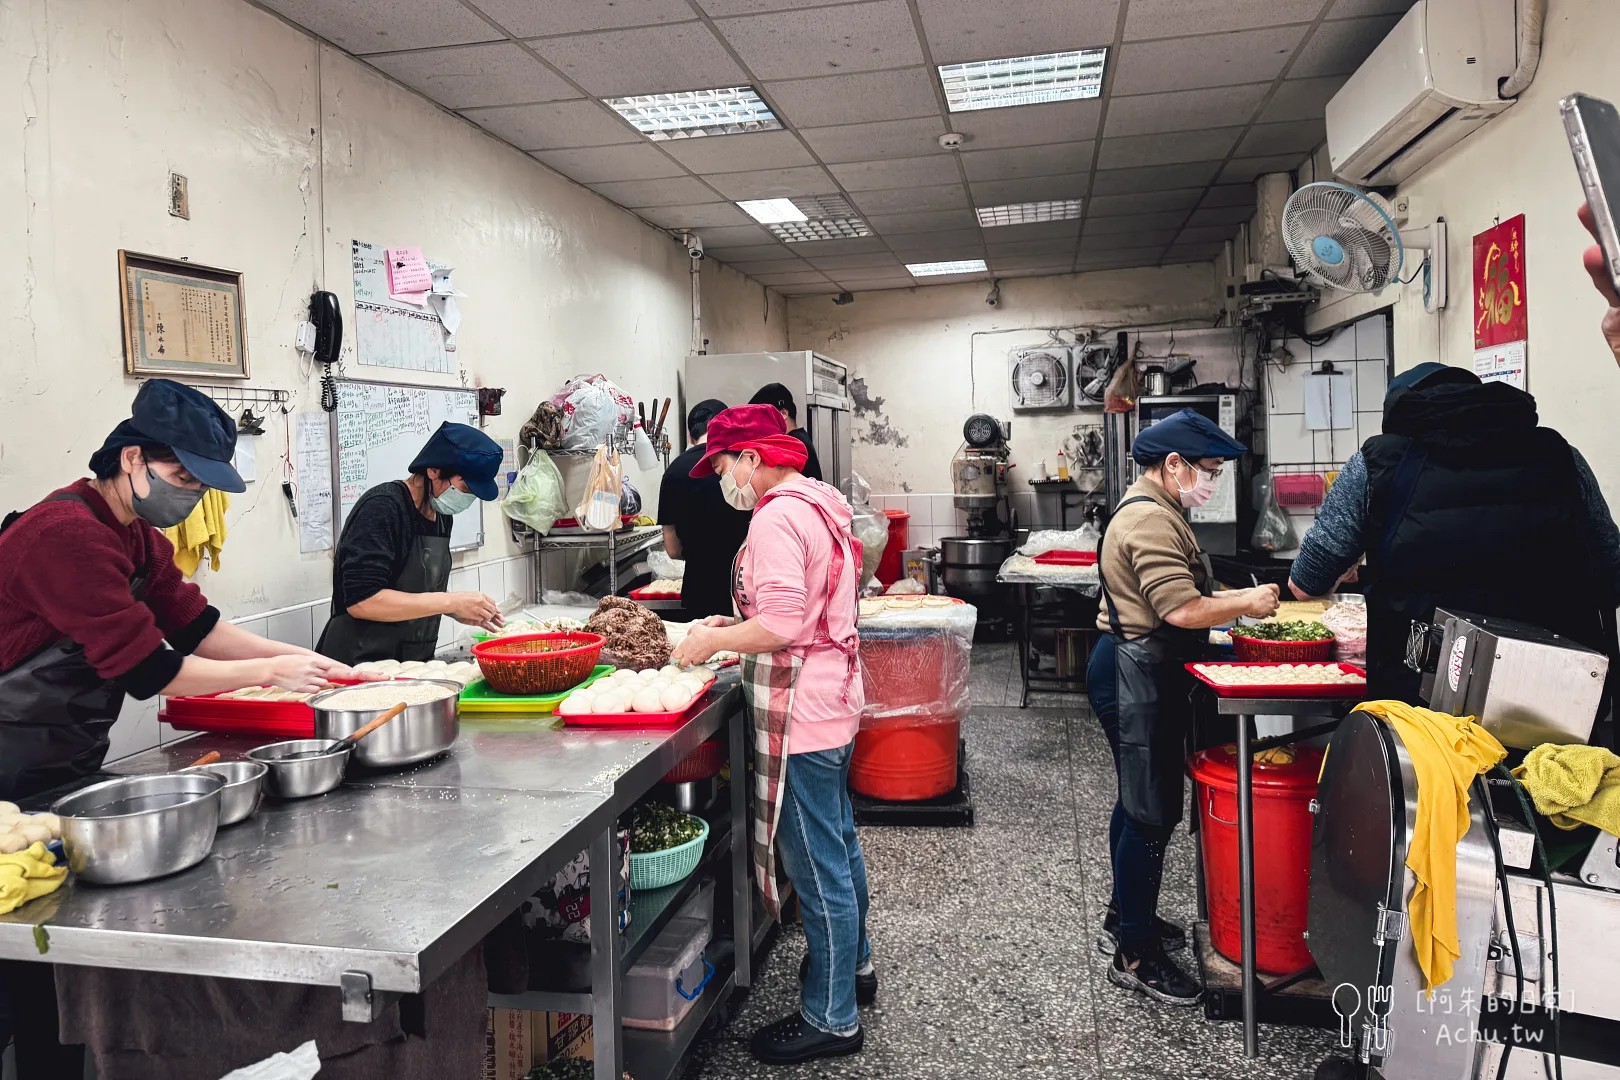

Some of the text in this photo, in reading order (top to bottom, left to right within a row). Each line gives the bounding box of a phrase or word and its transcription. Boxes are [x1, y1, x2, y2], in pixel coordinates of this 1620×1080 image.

[1485, 252, 1514, 329] 福
[157, 323, 165, 354] 陳水扁
